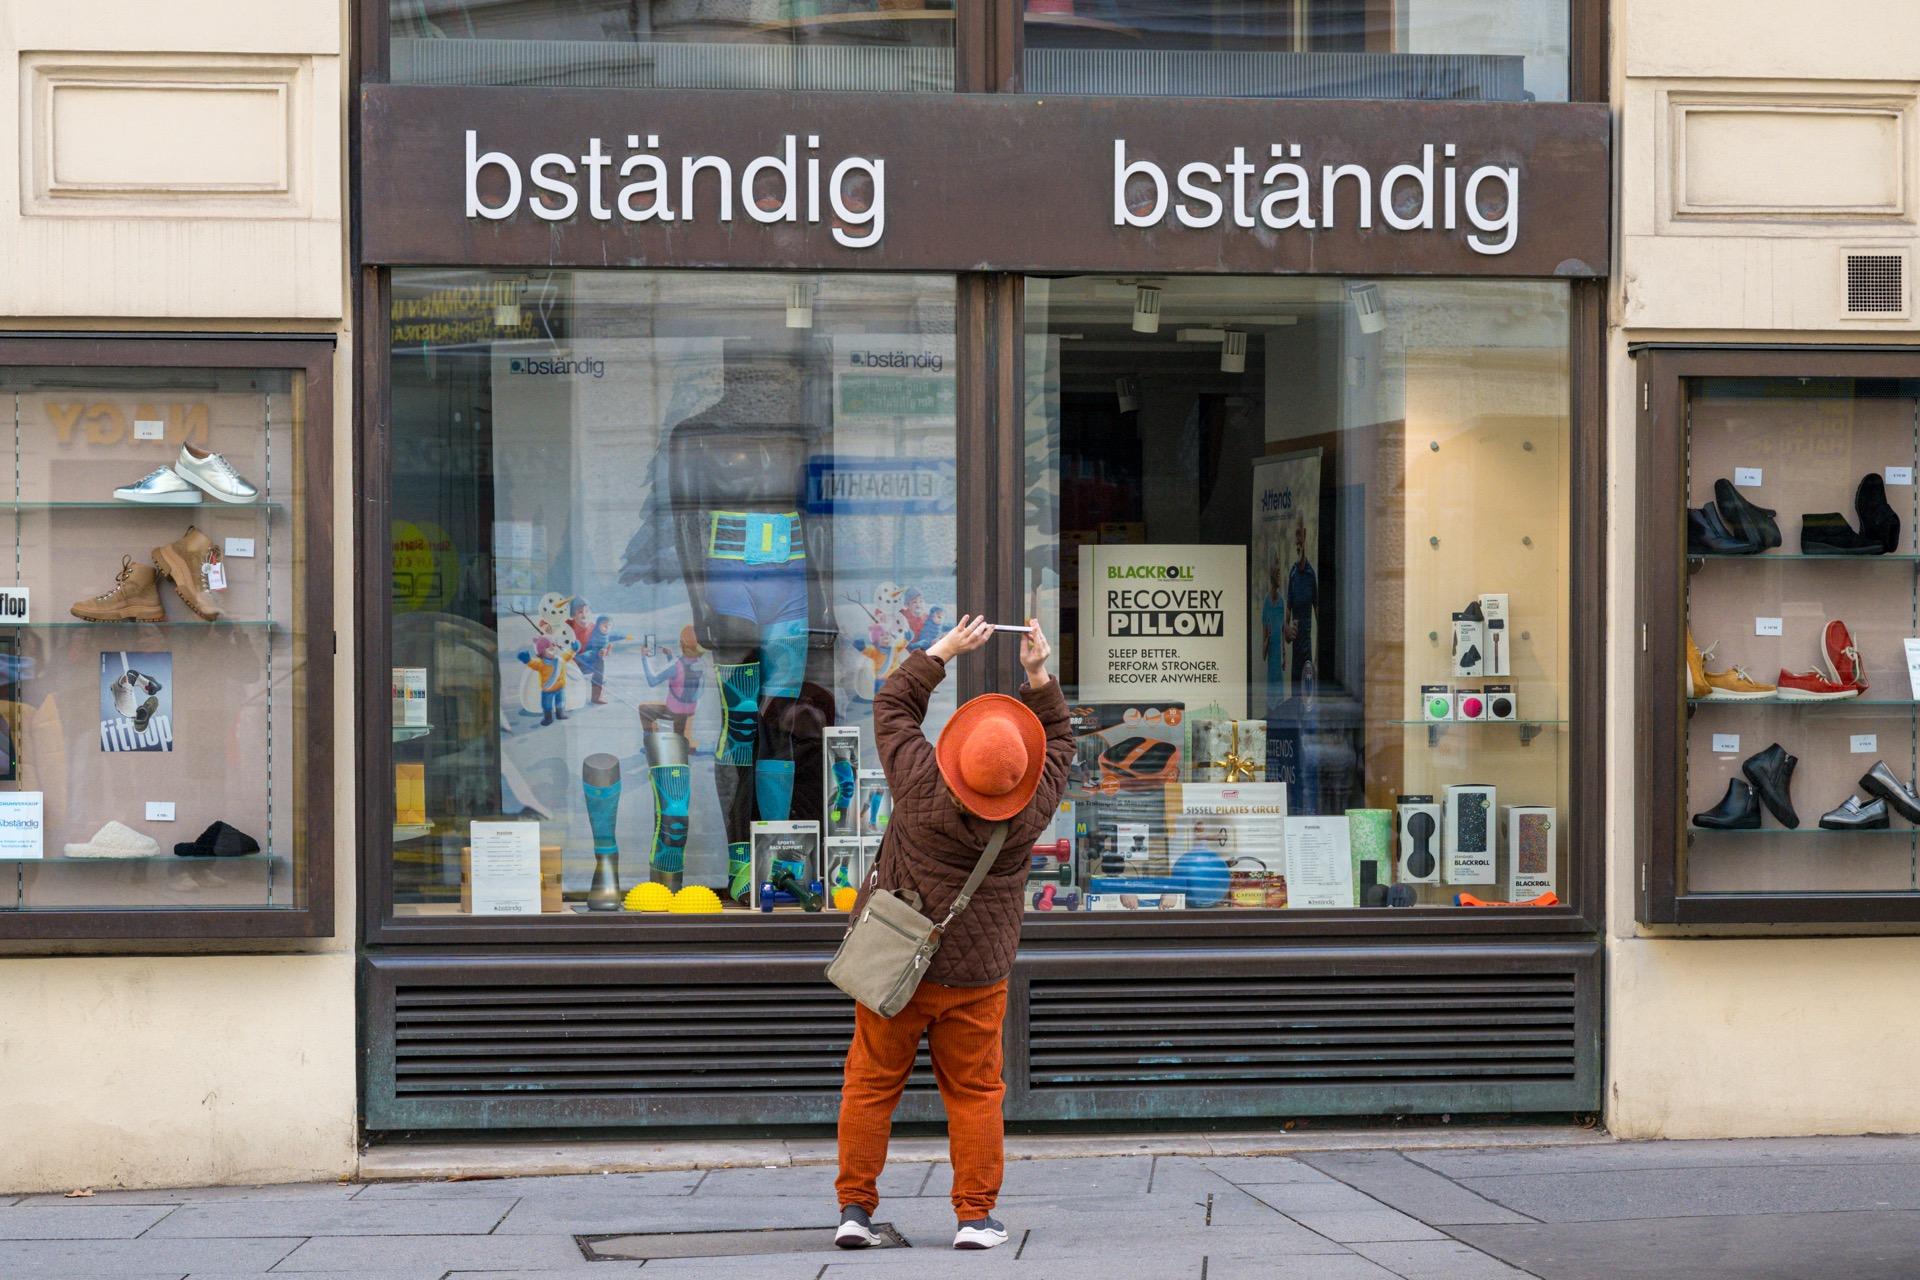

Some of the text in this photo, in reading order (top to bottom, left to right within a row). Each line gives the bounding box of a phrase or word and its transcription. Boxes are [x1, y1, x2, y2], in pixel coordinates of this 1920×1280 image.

[464, 128, 886, 248] bständig
[1113, 138, 1520, 255] bständig
[527, 356, 604, 379] bständig
[867, 351, 943, 373] bständig
[1262, 487, 1292, 512] Attends
[1107, 565, 1194, 579] BLACKROLL
[1108, 590, 1223, 609] RECOVERY
[1110, 612, 1222, 635] PILLOW
[1108, 649, 1180, 658] SLEEP BETTER.
[1108, 661, 1219, 671] PERFORM STRONGER.
[1108, 674, 1221, 683] RECOVER ANYWHERE.
[1186, 805, 1280, 814] SISSEL PILATES CIRCLE
